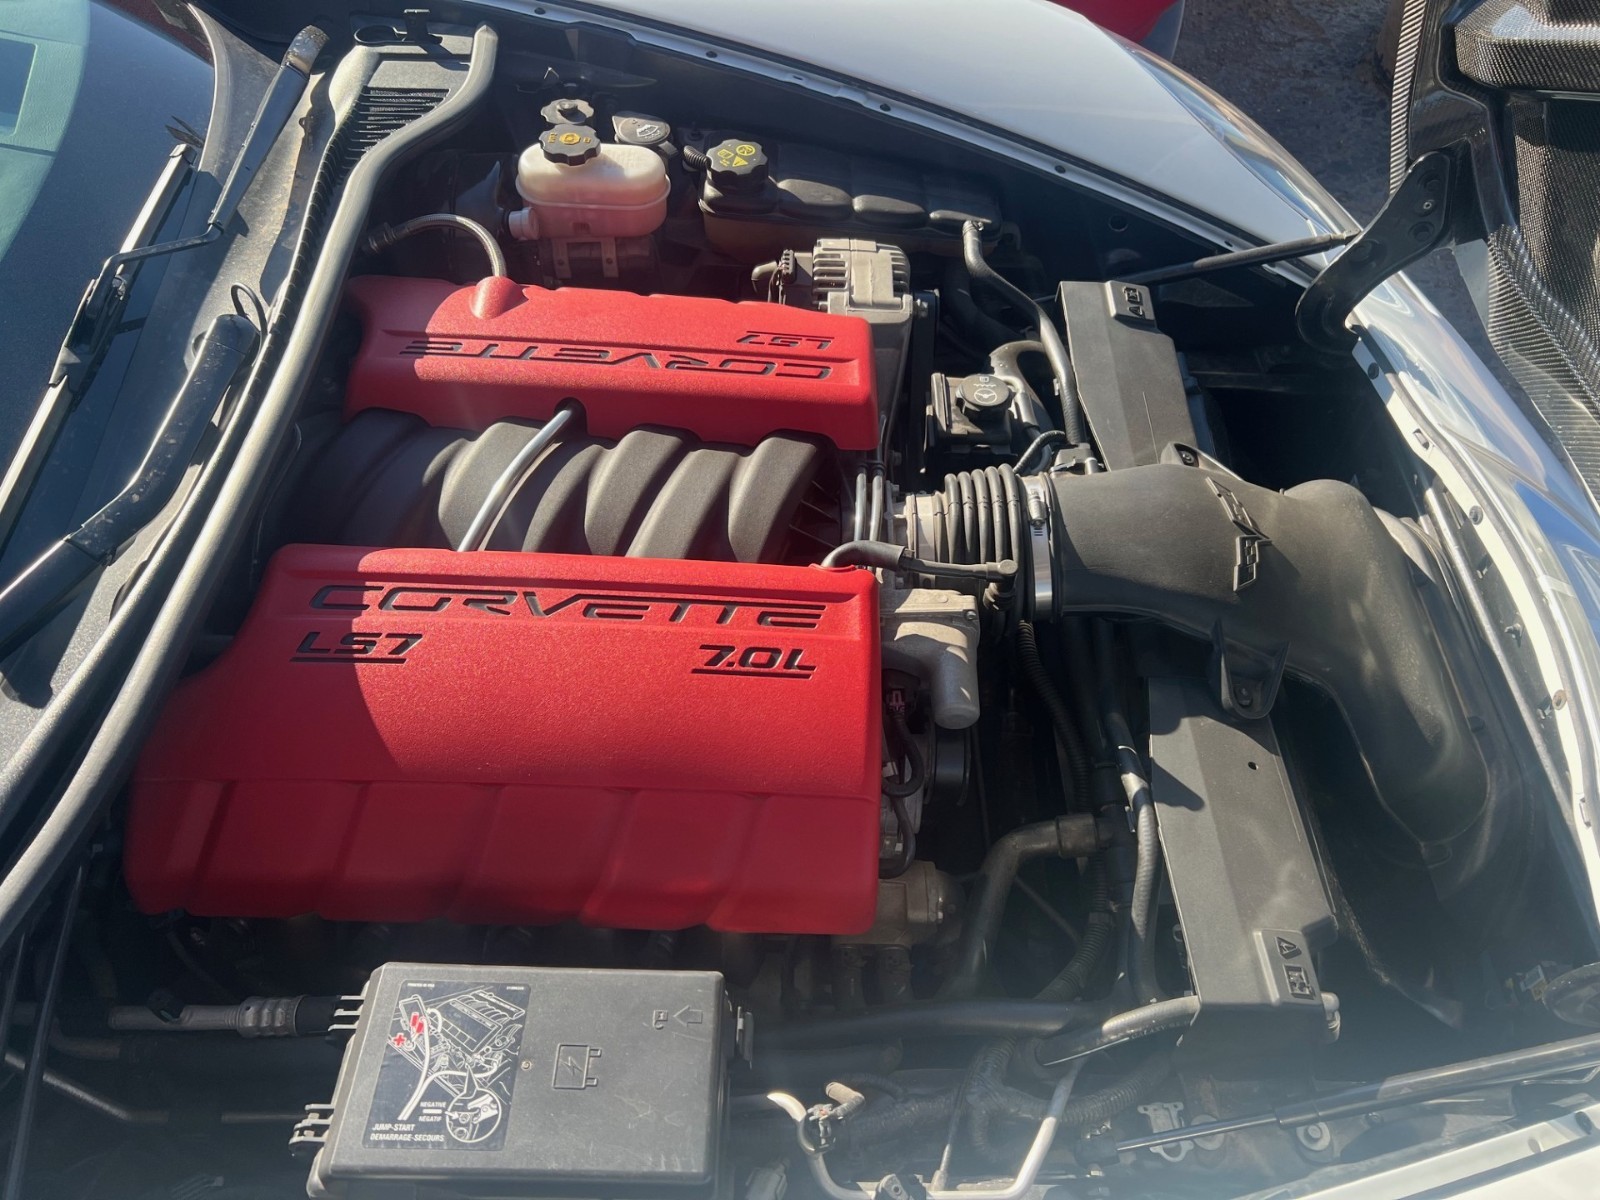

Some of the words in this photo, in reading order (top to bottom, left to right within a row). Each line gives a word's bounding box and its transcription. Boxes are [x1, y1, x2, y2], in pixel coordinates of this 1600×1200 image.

[736, 332, 834, 350] LS7
[400, 341, 832, 379] CORVETTE
[309, 584, 827, 629] CORVETTE
[296, 632, 423, 656] LS7
[697, 644, 817, 671] 7.0L
[372, 1123, 416, 1132] JUMP-START
